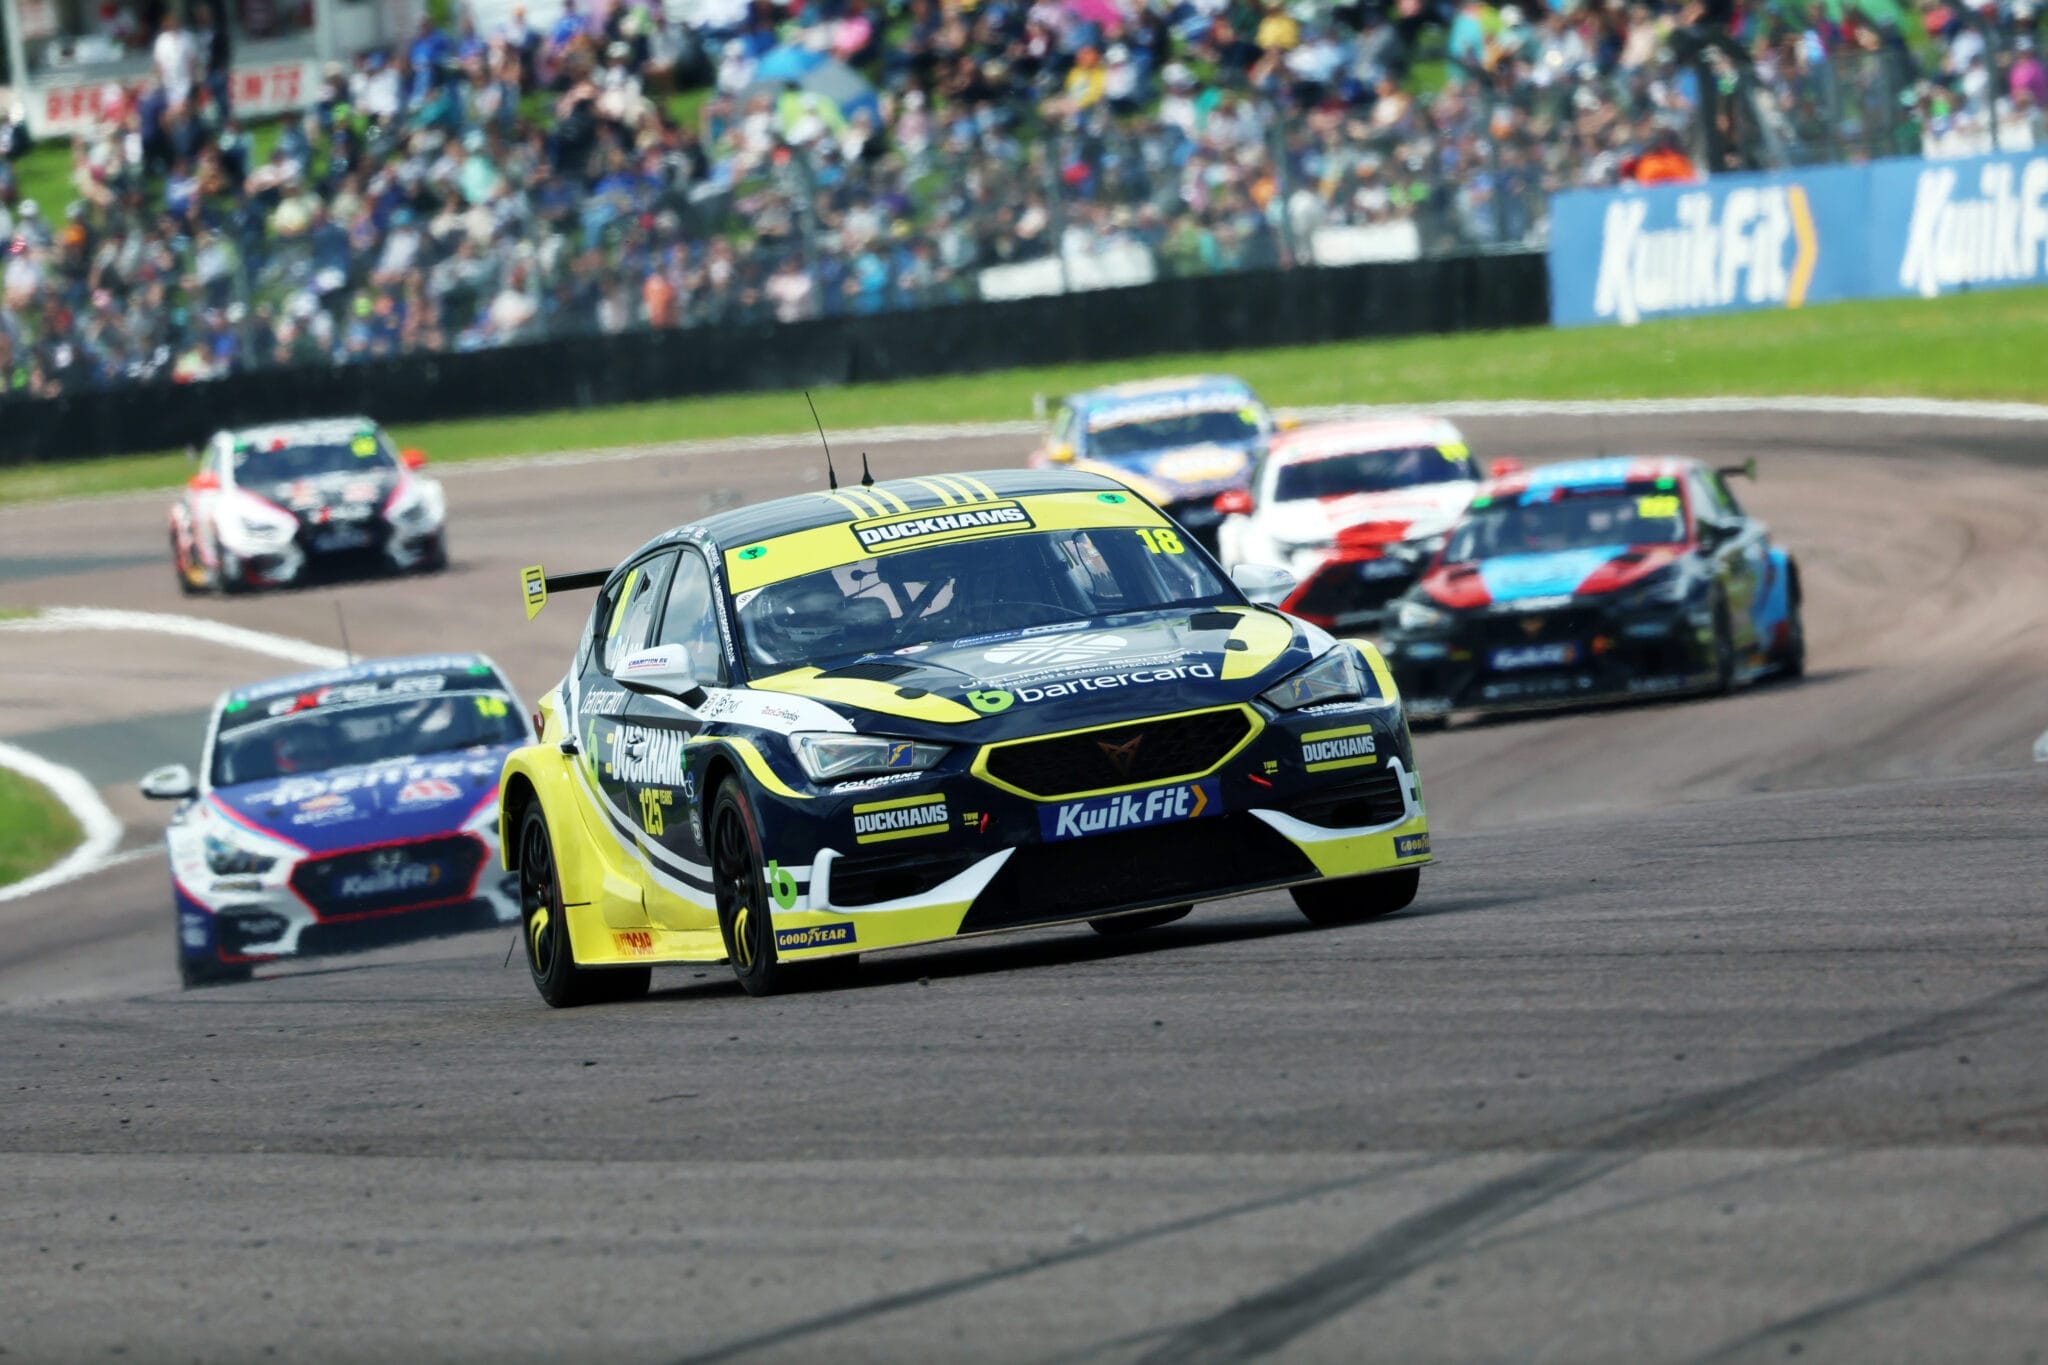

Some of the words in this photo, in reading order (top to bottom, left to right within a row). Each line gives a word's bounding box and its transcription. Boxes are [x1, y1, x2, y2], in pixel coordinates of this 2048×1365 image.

[857, 508, 1026, 545] DUCKHAMS
[1136, 528, 1185, 554] 18
[1015, 663, 1214, 702] bartercard
[580, 683, 626, 714] bartercard
[1302, 735, 1376, 763] DUCKHAMS
[640, 787, 664, 836] 125
[854, 804, 949, 834] DUCKHAMS
